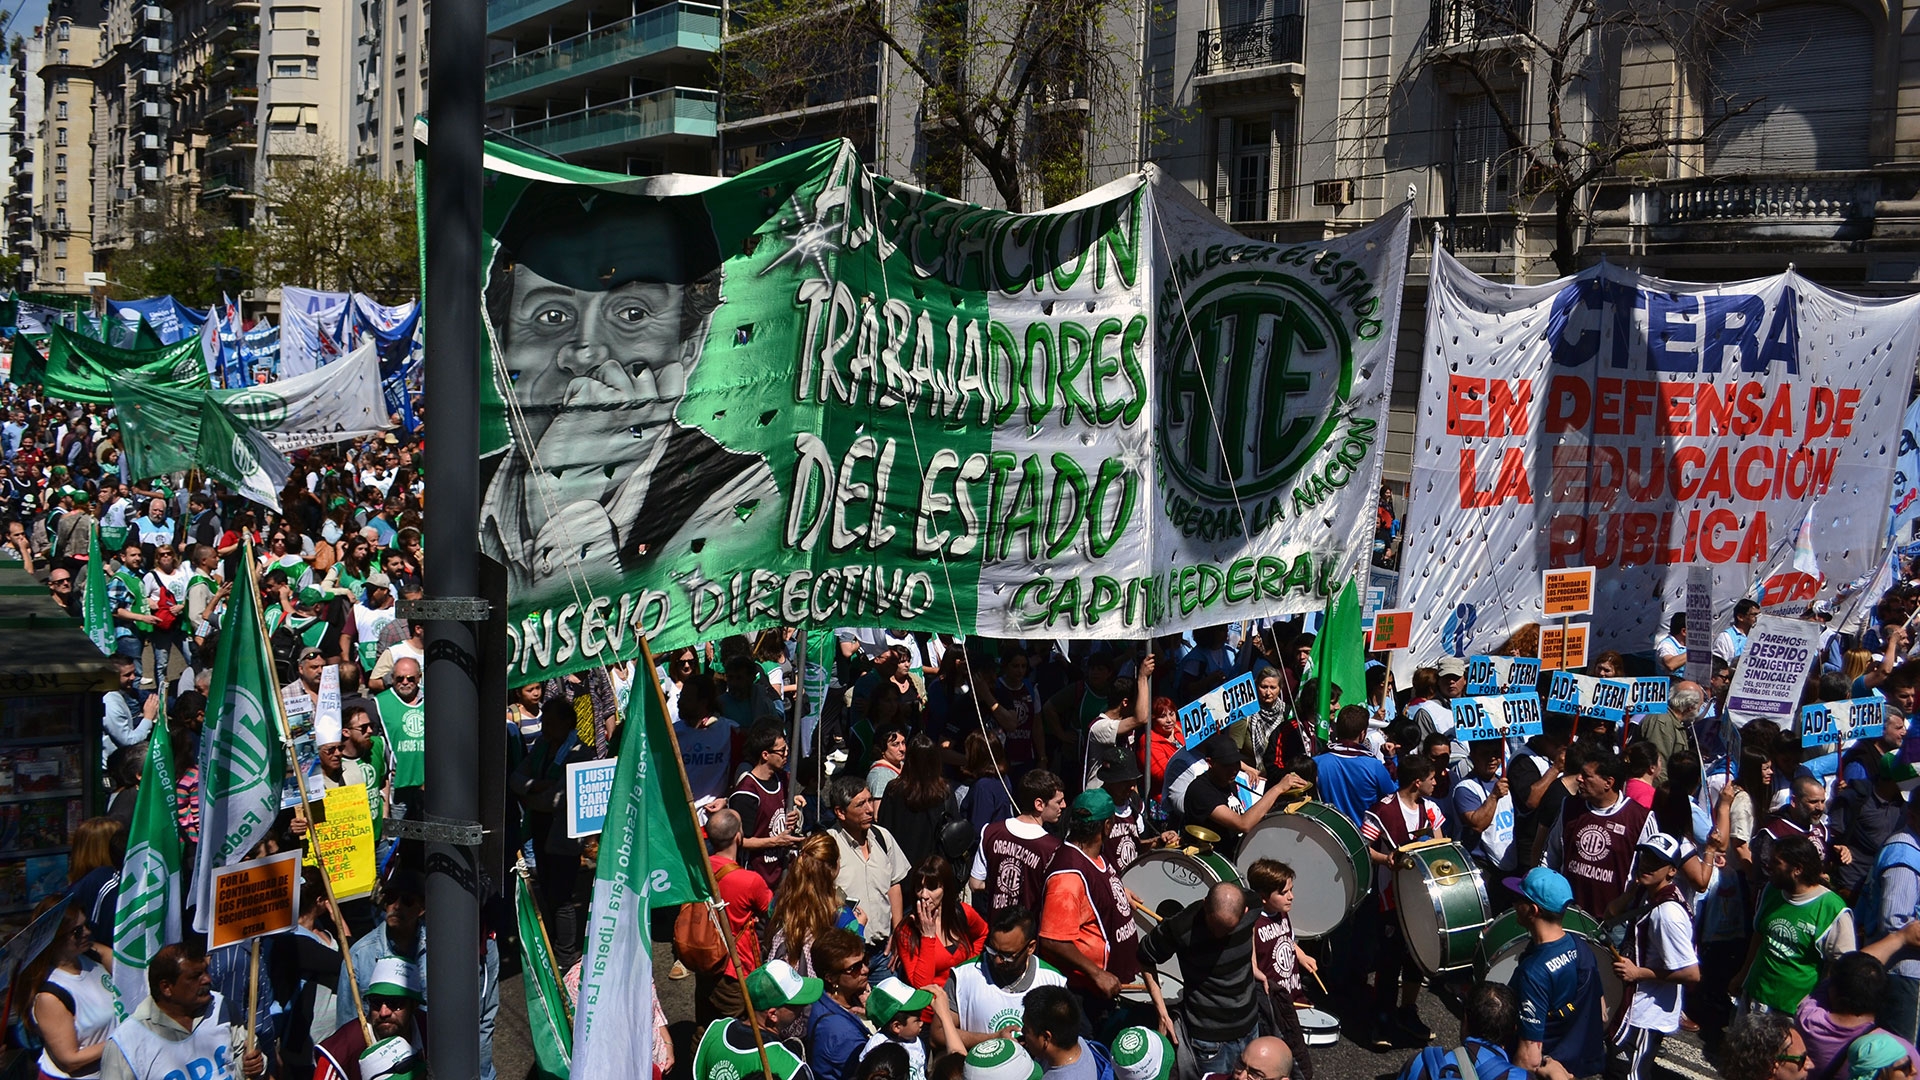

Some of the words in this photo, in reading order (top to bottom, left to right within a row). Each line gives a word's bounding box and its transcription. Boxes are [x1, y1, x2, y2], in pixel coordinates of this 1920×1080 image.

[1310, 250, 1384, 343] ESTADO
[1547, 278, 1799, 376] CTERA
[795, 279, 1148, 427] TRABAJADORES
[1171, 292, 1328, 484] ATE
[1446, 373, 1533, 438] EN
[1544, 375, 1792, 438] DEFENSA
[1804, 386, 1861, 438] DE
[1165, 487, 1248, 544] LIBERAR
[1252, 497, 1286, 536] LA
[1292, 417, 1378, 518] NACION
[1459, 447, 1534, 510] LA
[785, 432, 896, 551] DEL
[915, 448, 1138, 563] ESTADO
[1169, 551, 1341, 620] FEDERAL
[1547, 589, 1557, 597] LOS
[1556, 587, 1587, 596] PROGRAMAS
[507, 588, 671, 676] ONSEJO
[692, 564, 936, 634] DIRECTIVO
[1749, 642, 1809, 662] DESPIDO
[1758, 632, 1802, 647] PAREMOS
[1468, 661, 1495, 684] ADF
[1507, 662, 1538, 685] CTERA
[1742, 657, 1748, 665] A
[1748, 657, 1806, 673] DIRIGENTES
[1743, 668, 1798, 684] SINDICALES
[1549, 675, 1578, 702] ADF
[1591, 682, 1626, 710] CTERA
[1631, 681, 1666, 703] CTERA
[1741, 687, 1761, 696] TIERRA
[1771, 690, 1790, 698] FUEGO
[1743, 680, 1754, 688] DEL
[1754, 681, 1771, 689] SUTEF
[1183, 702, 1208, 738] ADF
[1222, 679, 1256, 714] CTERA
[1456, 703, 1484, 729] ADF
[1502, 698, 1540, 724] CTERA
[1803, 708, 1832, 735] ADF
[1849, 702, 1882, 728] CTERA
[683, 752, 724, 766] GMER
[584, 766, 615, 784] JUSTI
[579, 805, 608, 819] FUEN
[320, 838, 352, 851] ESPETO
[220, 874, 238, 889] POR
[240, 872, 249, 884] LA
[1170, 860, 1199, 885] VSG
[219, 877, 277, 901] CONTINUIDAD
[278, 874, 289, 885] DE
[219, 900, 235, 913] LOS
[236, 886, 288, 909] PROGRAMAS
[218, 898, 290, 926] SOCIOEDUCATIVOS
[242, 921, 265, 936] CTERA
[988, 1008, 1014, 1030] FORTALECER
